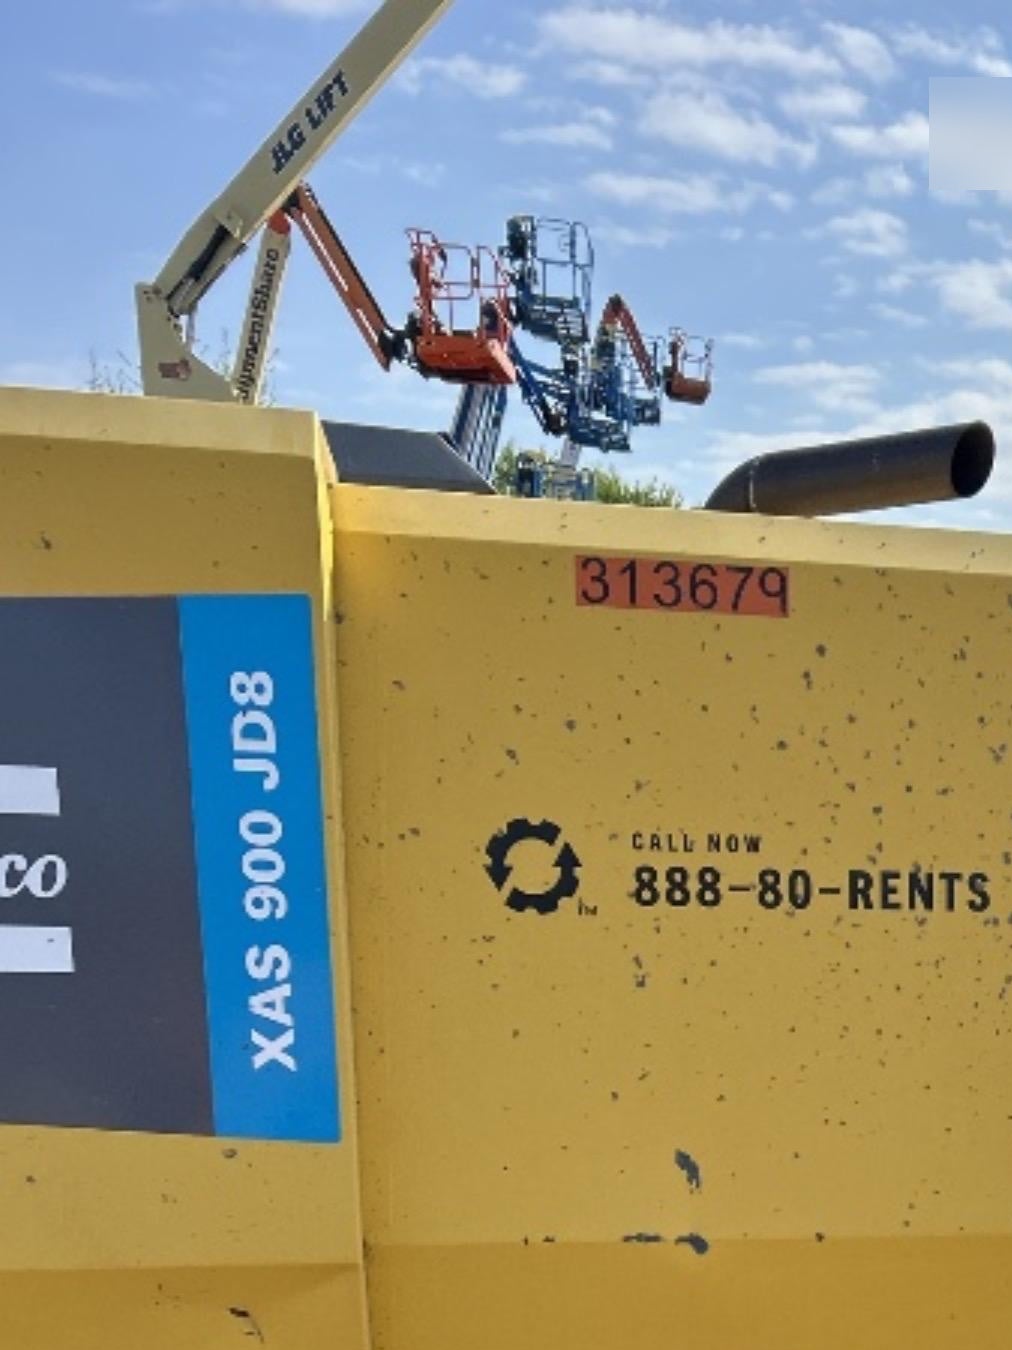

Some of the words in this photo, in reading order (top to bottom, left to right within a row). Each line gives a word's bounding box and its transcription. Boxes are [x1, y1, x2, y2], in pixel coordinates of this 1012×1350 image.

[271, 121, 306, 174] JLG
[304, 68, 348, 130] LIFT
[580, 556, 788, 615] 313679
[230, 669, 281, 792] JD8
[238, 810, 289, 920] 900
[631, 832, 694, 853] CALL
[706, 833, 762, 853] NOW
[633, 865, 992, 913] 888-80-RENTS
[245, 943, 297, 1072] XAS
